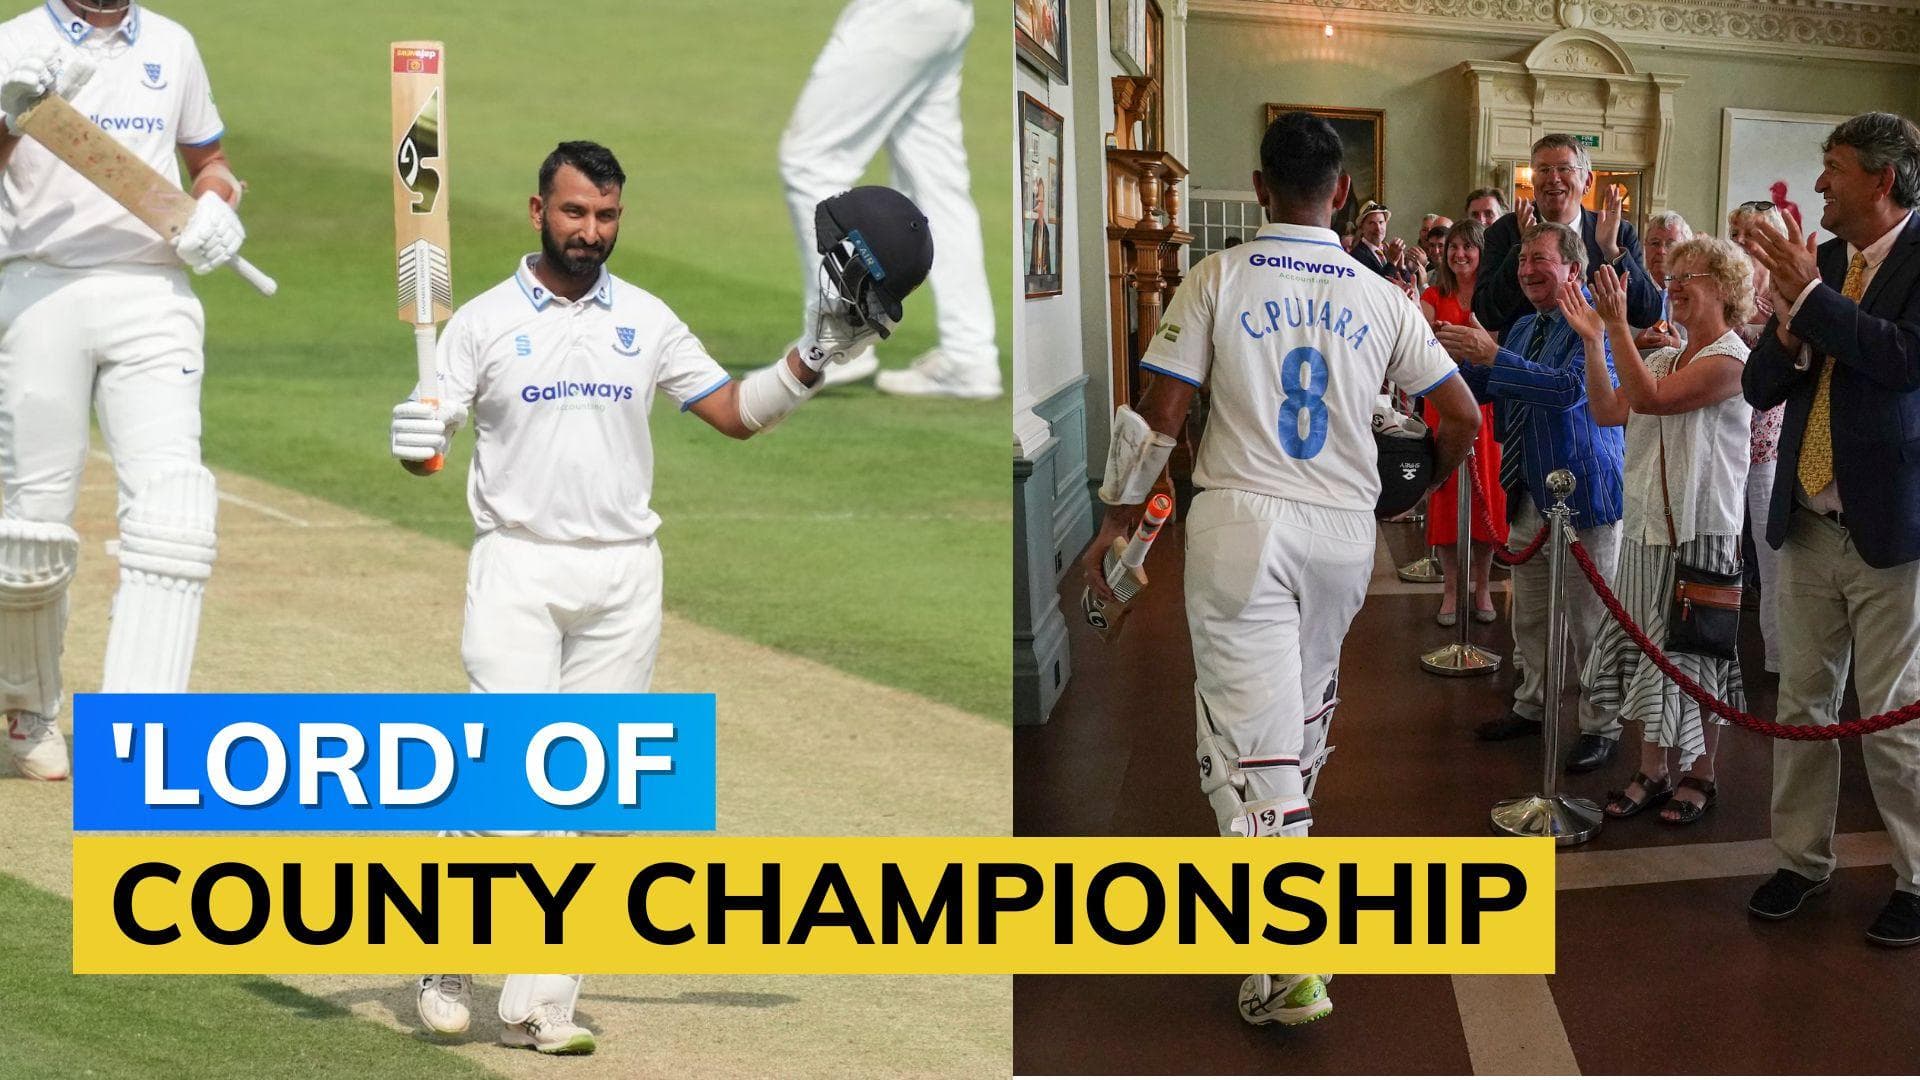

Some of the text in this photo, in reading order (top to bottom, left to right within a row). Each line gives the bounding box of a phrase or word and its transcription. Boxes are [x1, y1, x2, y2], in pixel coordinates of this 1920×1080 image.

[91, 114, 164, 133] loways
[1249, 254, 1356, 278] Galloways
[1241, 297, 1369, 350] C.PUJARA
[521, 380, 632, 403] Galloways
[1277, 347, 1327, 460] 8
